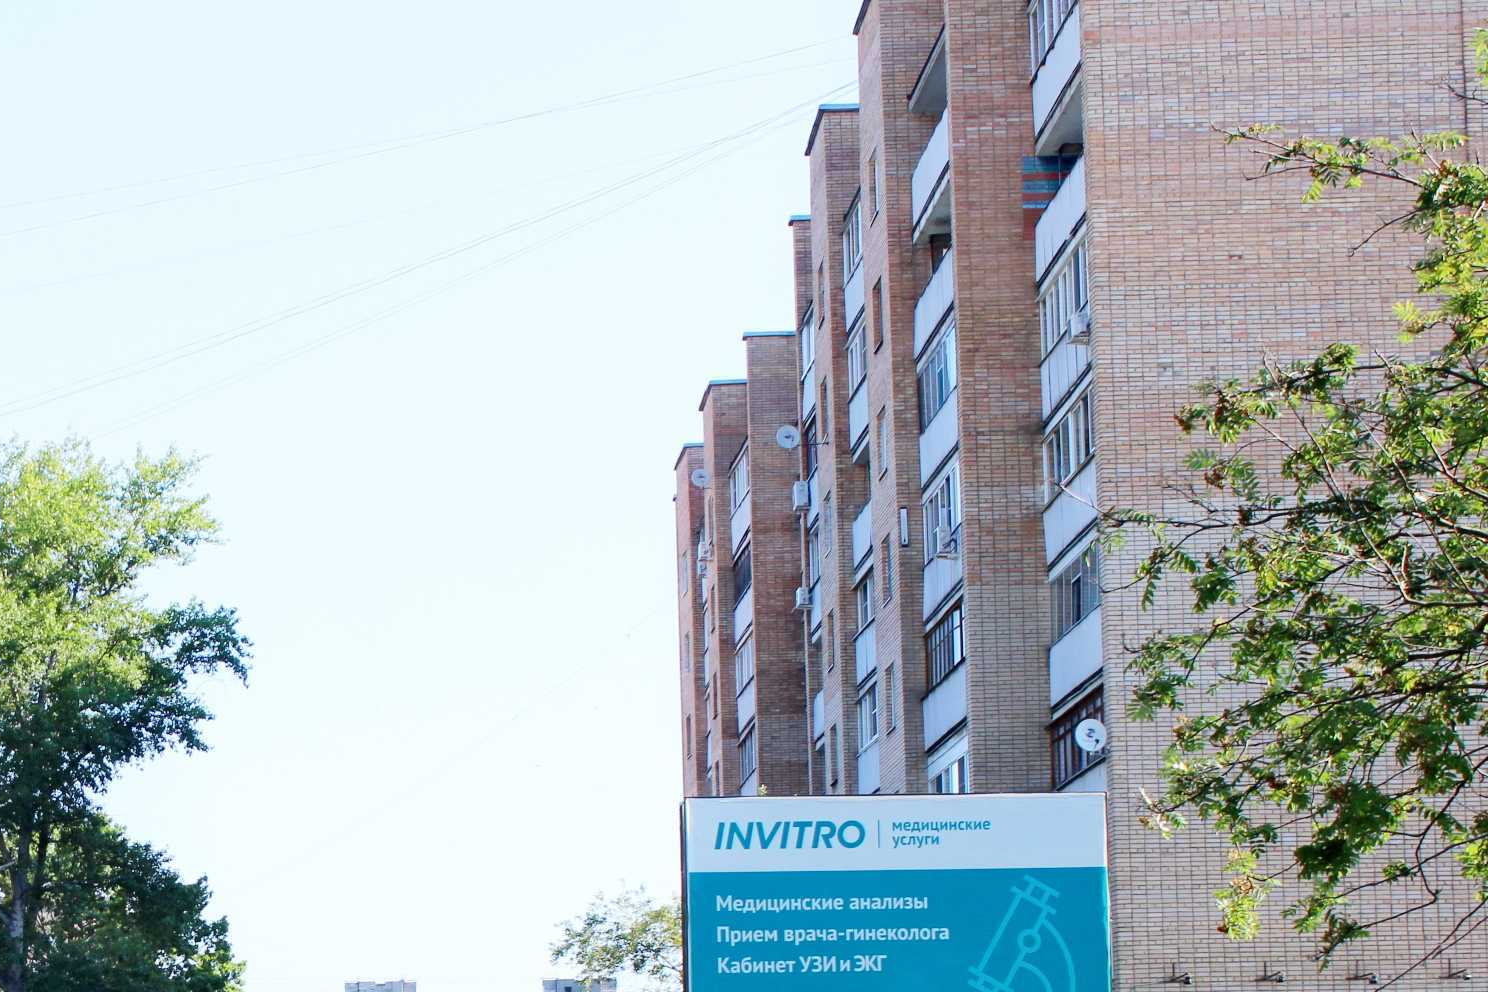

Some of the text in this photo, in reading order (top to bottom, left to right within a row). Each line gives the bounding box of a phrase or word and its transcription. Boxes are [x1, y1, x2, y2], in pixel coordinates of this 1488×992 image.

[714, 819, 866, 850] INVITRO
[892, 819, 991, 833] медицинские
[892, 834, 940, 848] услуги
[715, 895, 928, 913] Медицинские анализы
[716, 925, 950, 946] Прием врача-гинеколога
[717, 954, 888, 974] Кабинет УЗИ и ЭКГ
